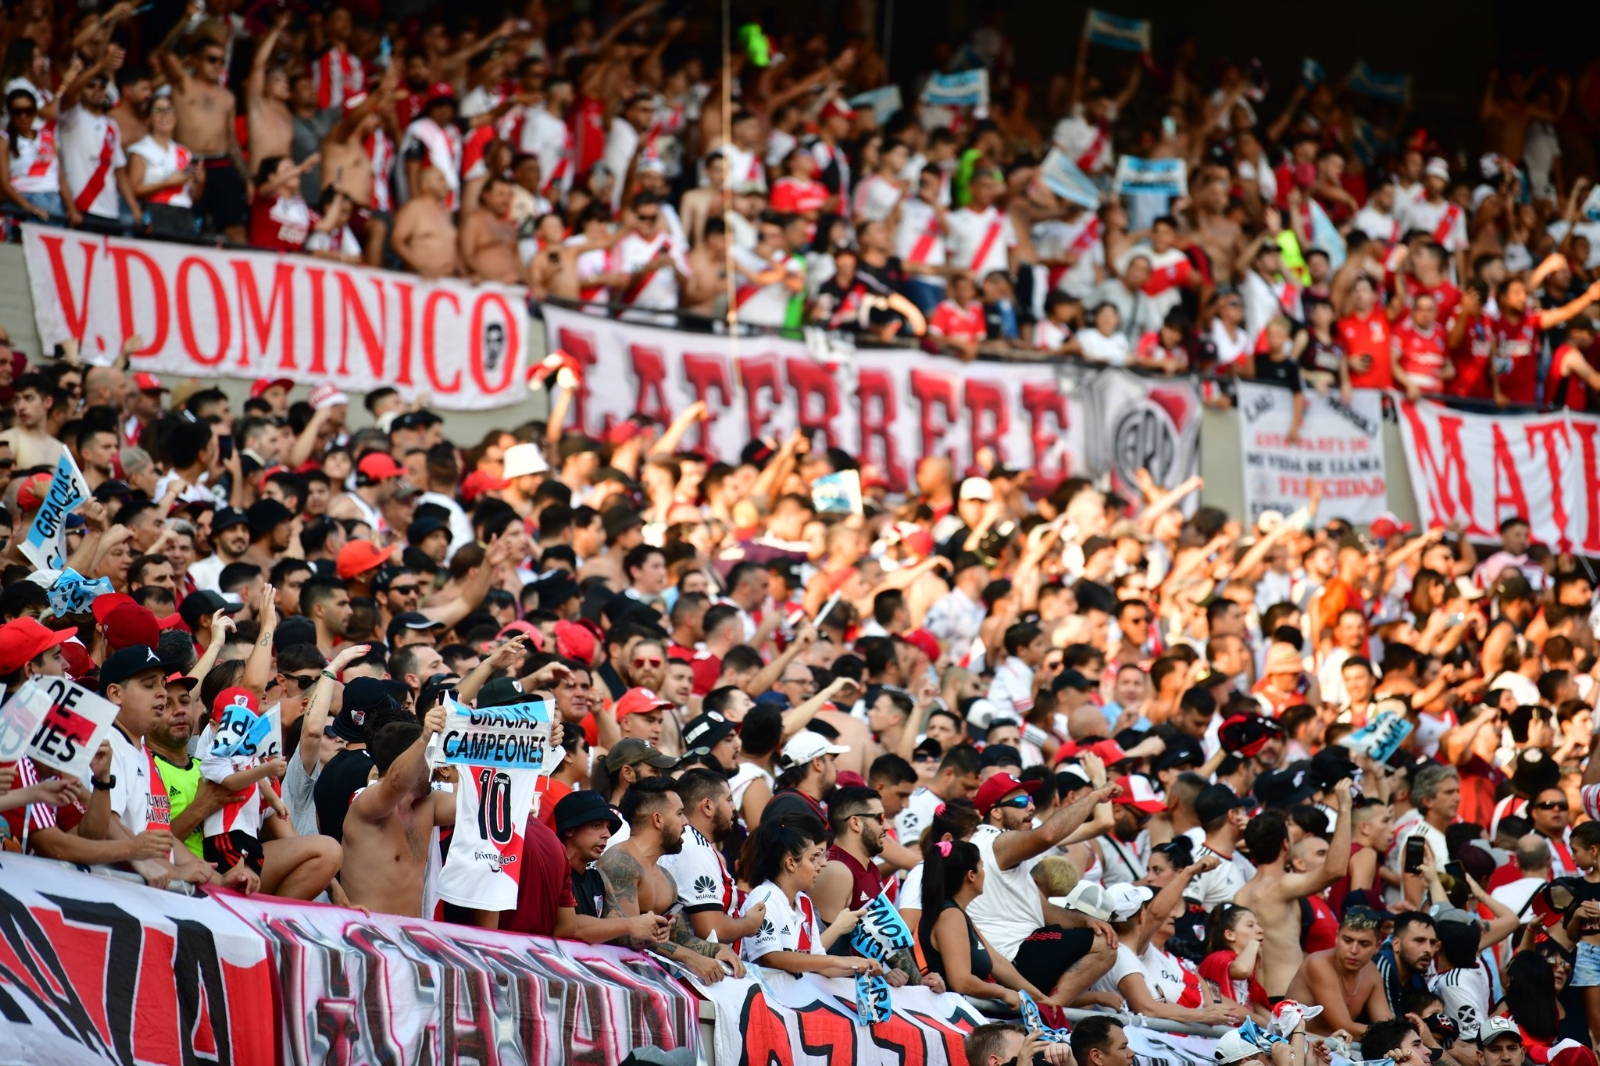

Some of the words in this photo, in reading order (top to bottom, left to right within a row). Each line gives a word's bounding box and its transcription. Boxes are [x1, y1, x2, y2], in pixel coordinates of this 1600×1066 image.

[558, 326, 1068, 501] LAFERRERE
[469, 705, 538, 730] GRACIAS
[442, 730, 546, 764] CAMPEONES
[478, 768, 512, 844] 10
